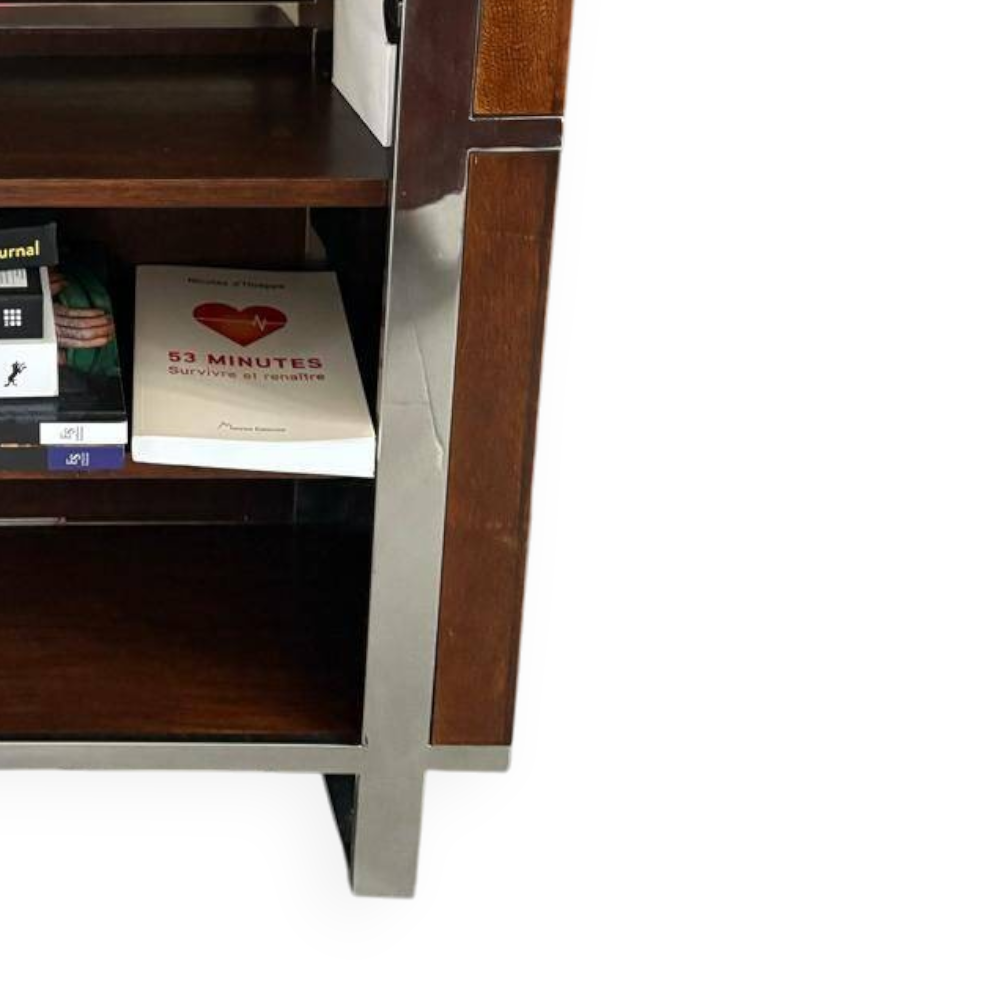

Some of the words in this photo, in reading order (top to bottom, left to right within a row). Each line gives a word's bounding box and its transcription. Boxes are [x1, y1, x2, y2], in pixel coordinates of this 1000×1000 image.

[168, 350, 197, 363] 53
[207, 353, 324, 369] MINUTES
[168, 365, 237, 379] Survivre
[243, 372, 258, 380] et
[263, 371, 326, 382] renaître
